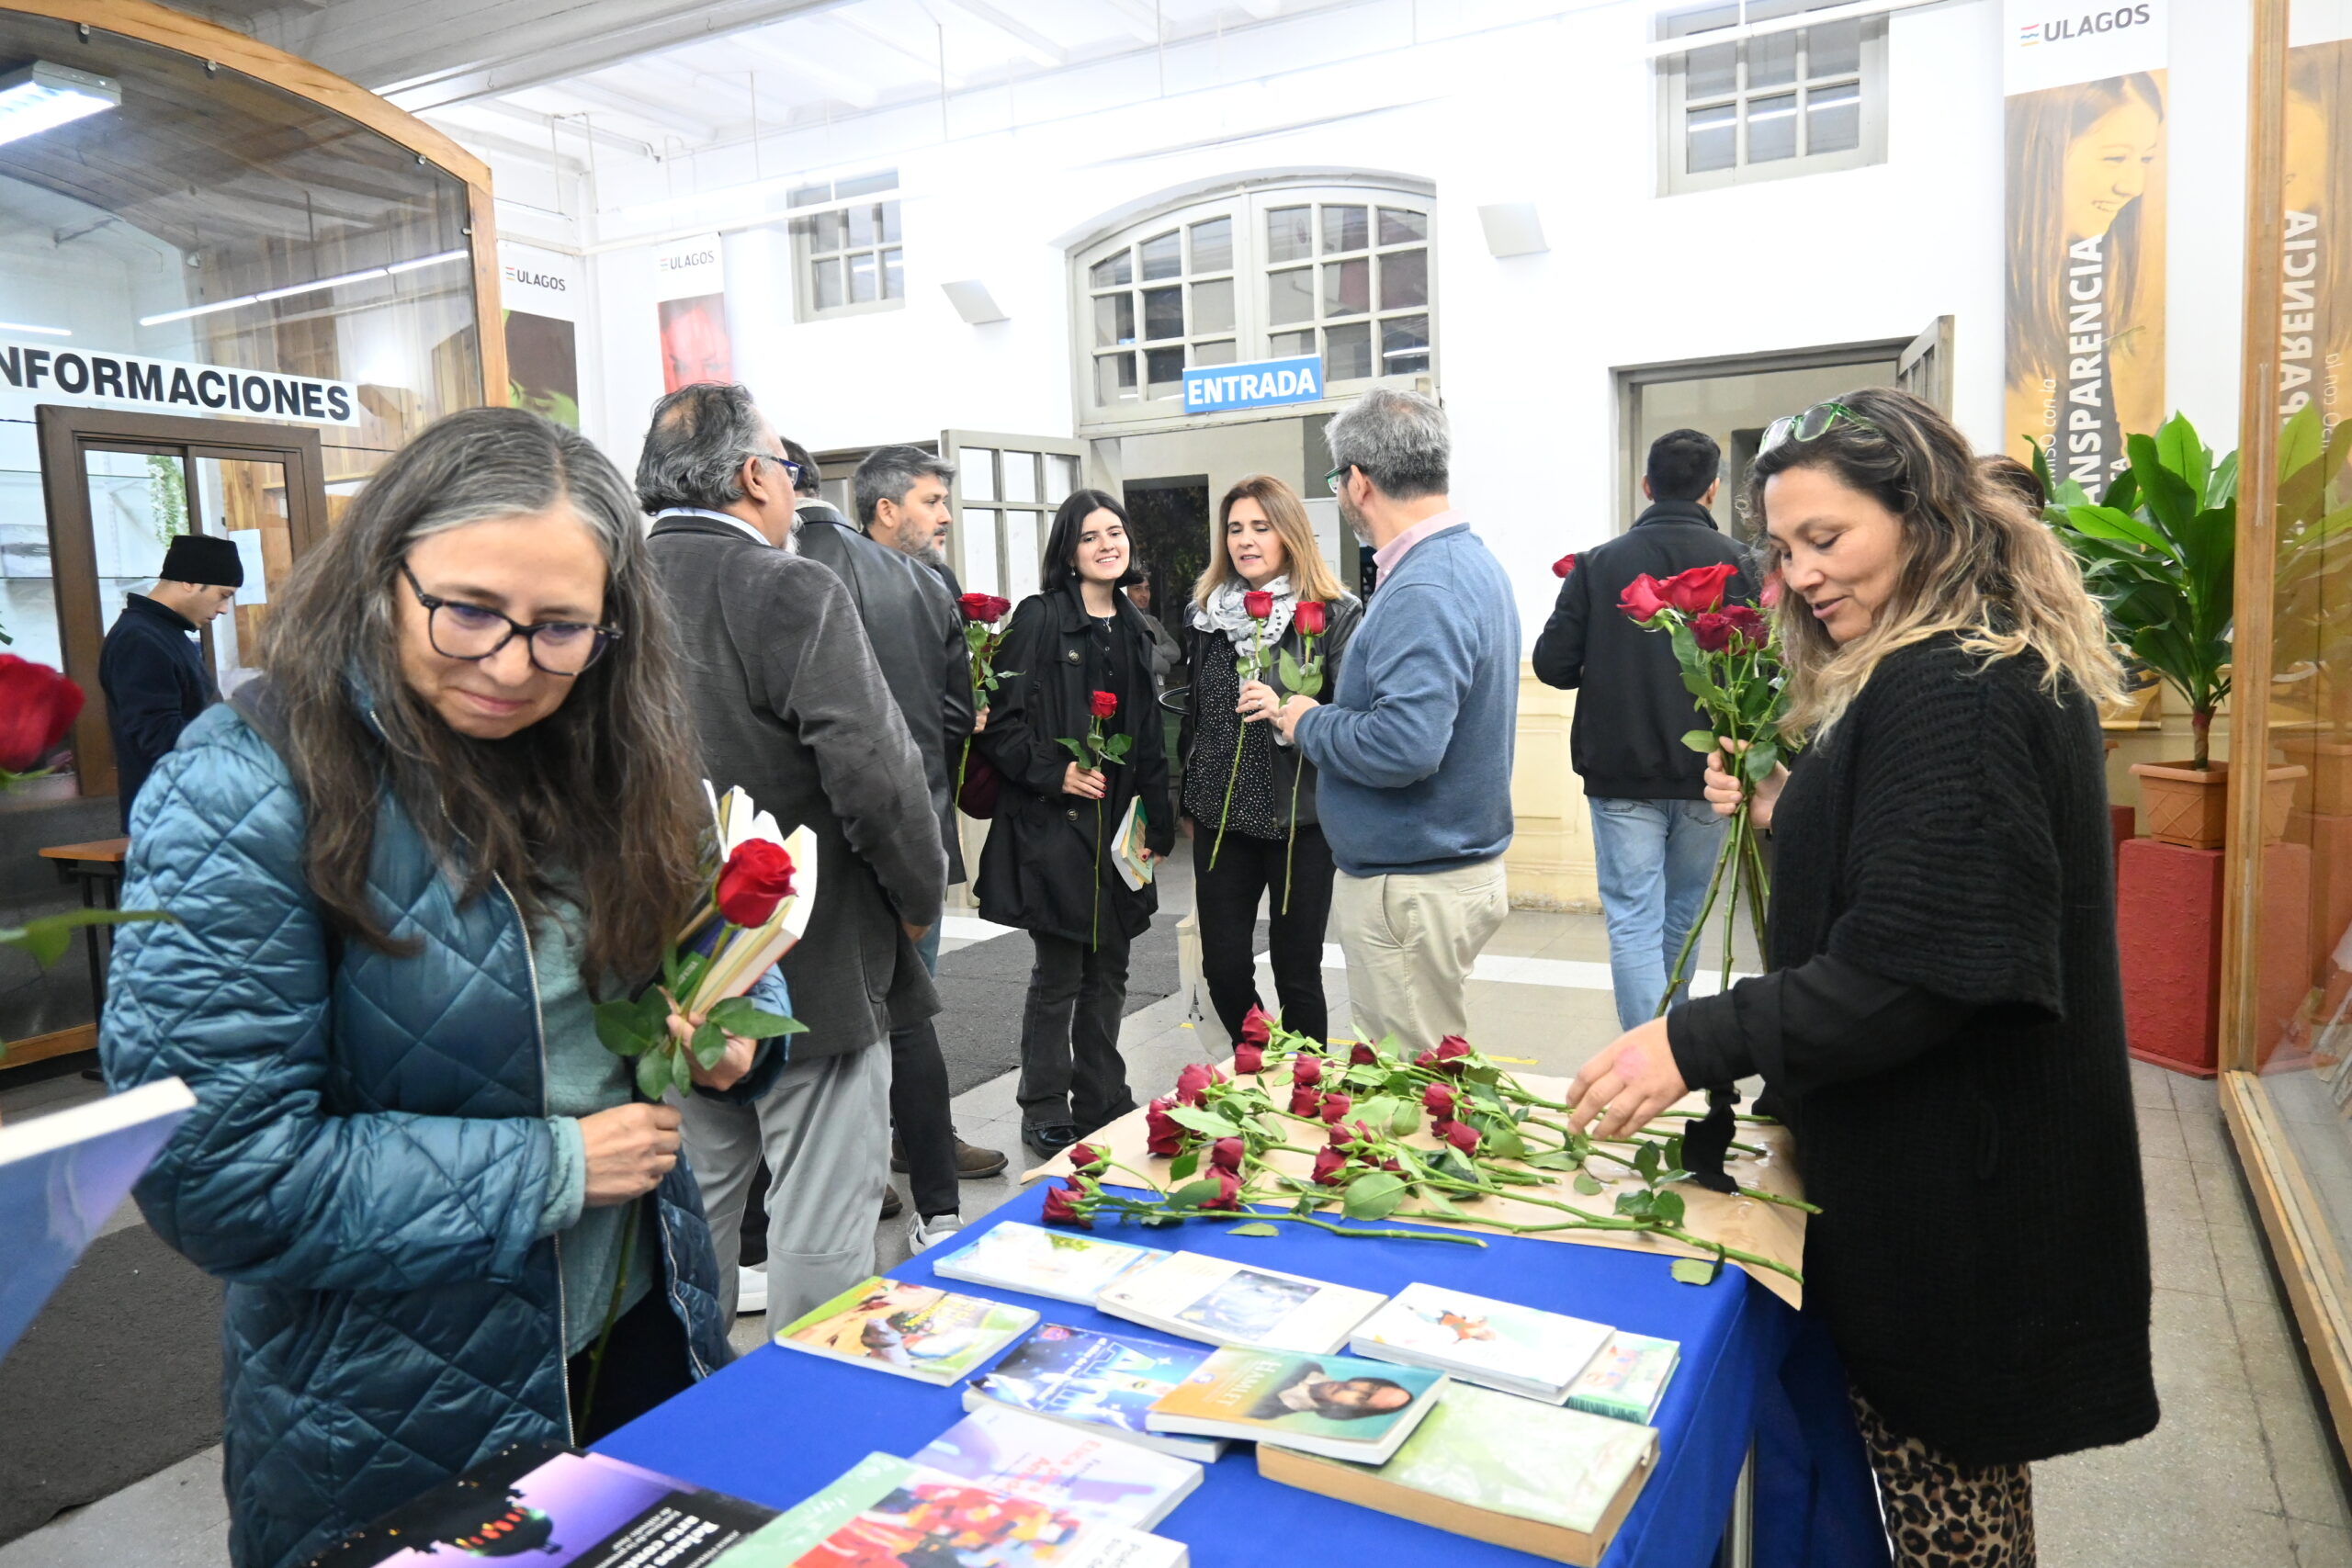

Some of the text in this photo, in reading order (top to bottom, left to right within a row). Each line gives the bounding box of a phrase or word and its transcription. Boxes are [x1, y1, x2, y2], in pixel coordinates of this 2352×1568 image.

[2044, 4, 2150, 41] ULAGOS
[670, 250, 715, 270] ULAGOS
[516, 268, 566, 292] ULAGOS
[1187, 367, 1317, 406] ENTRADA
[2039, 378, 2056, 427] con la
